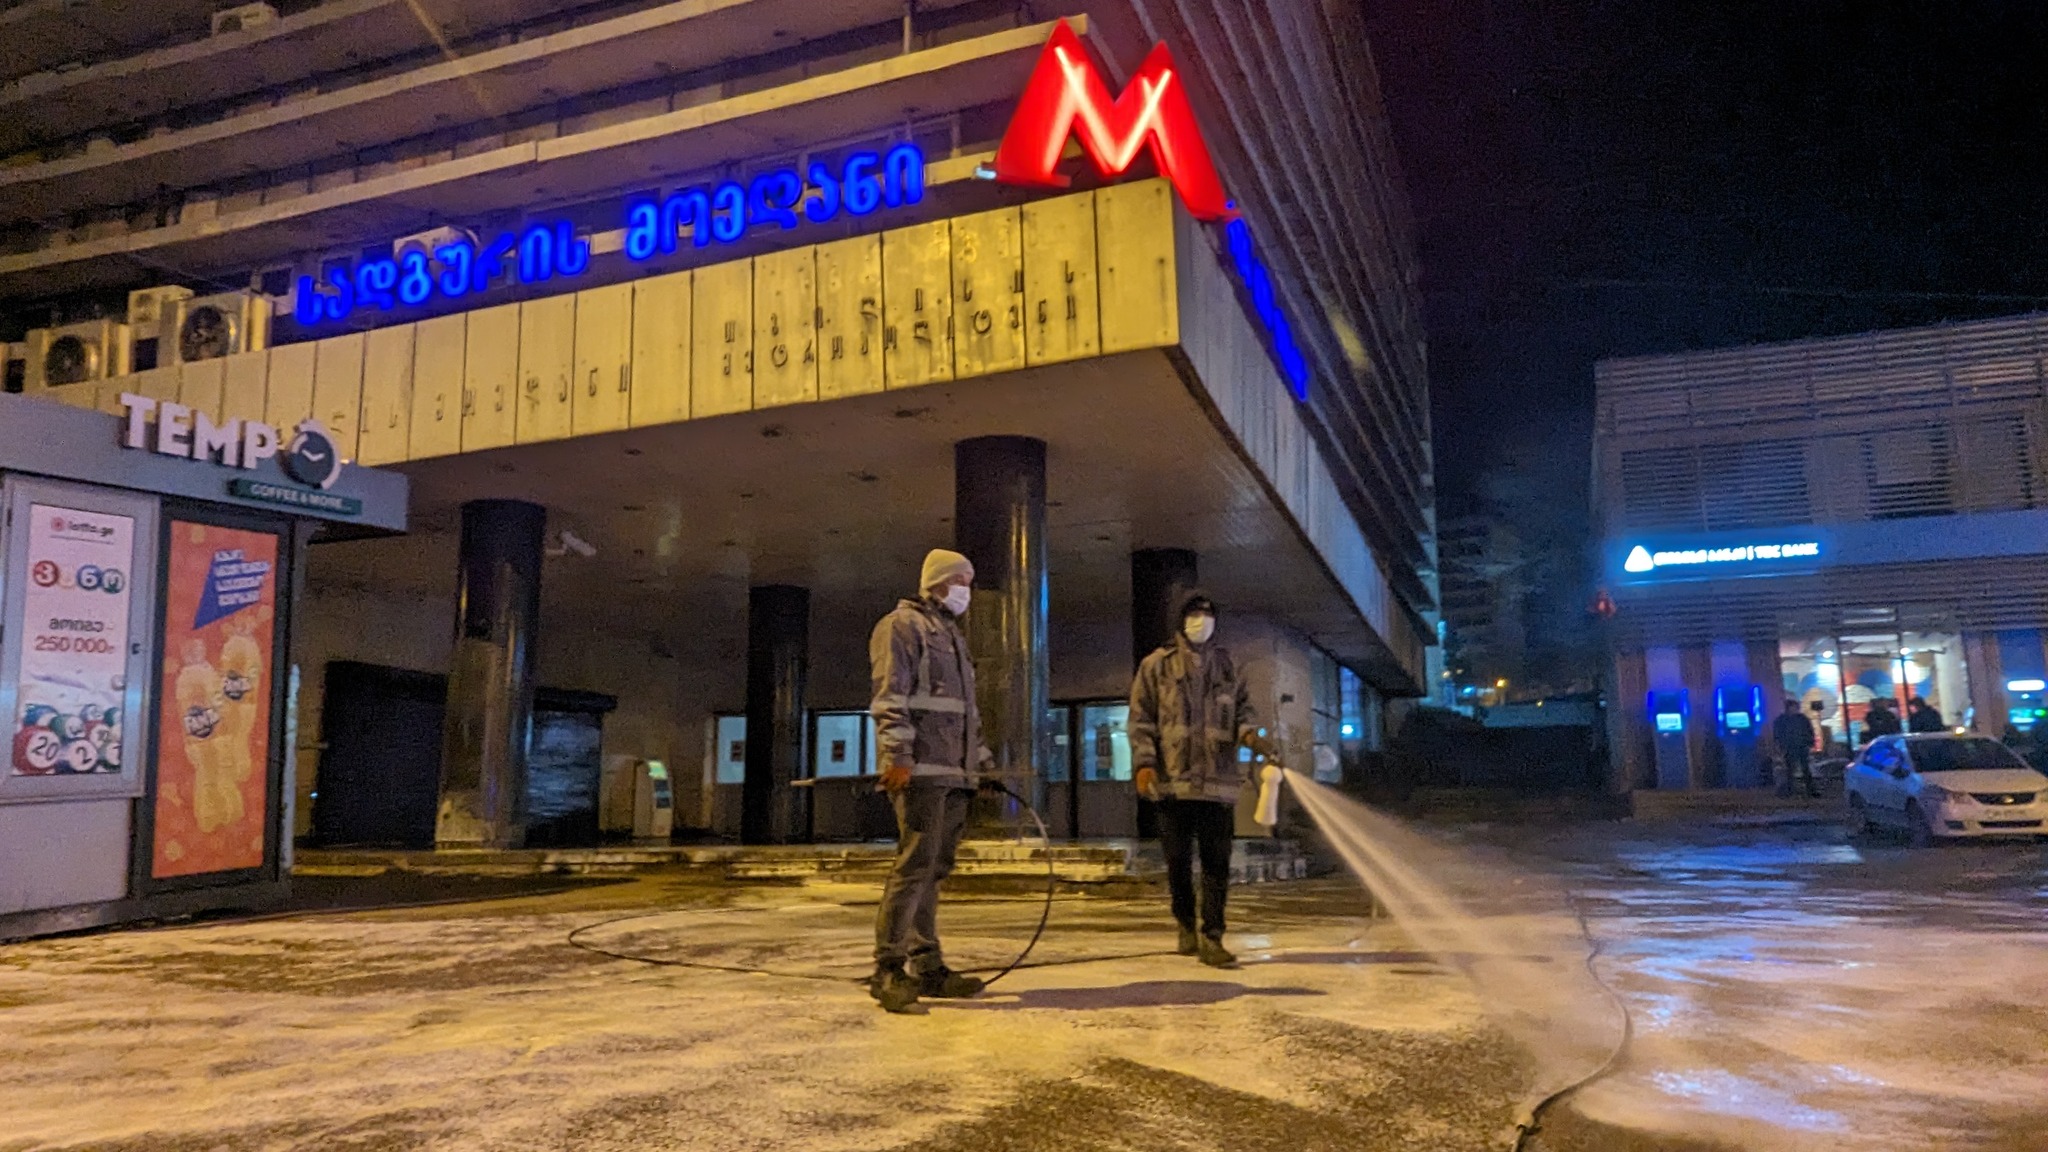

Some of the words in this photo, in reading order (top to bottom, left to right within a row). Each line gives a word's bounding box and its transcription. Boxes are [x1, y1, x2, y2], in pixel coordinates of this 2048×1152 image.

[994, 16, 1241, 221] M
[294, 219, 591, 326] სადგურის
[625, 142, 924, 262] მოედანი
[35, 635, 70, 652] 250
[32, 736, 59, 761] 20
